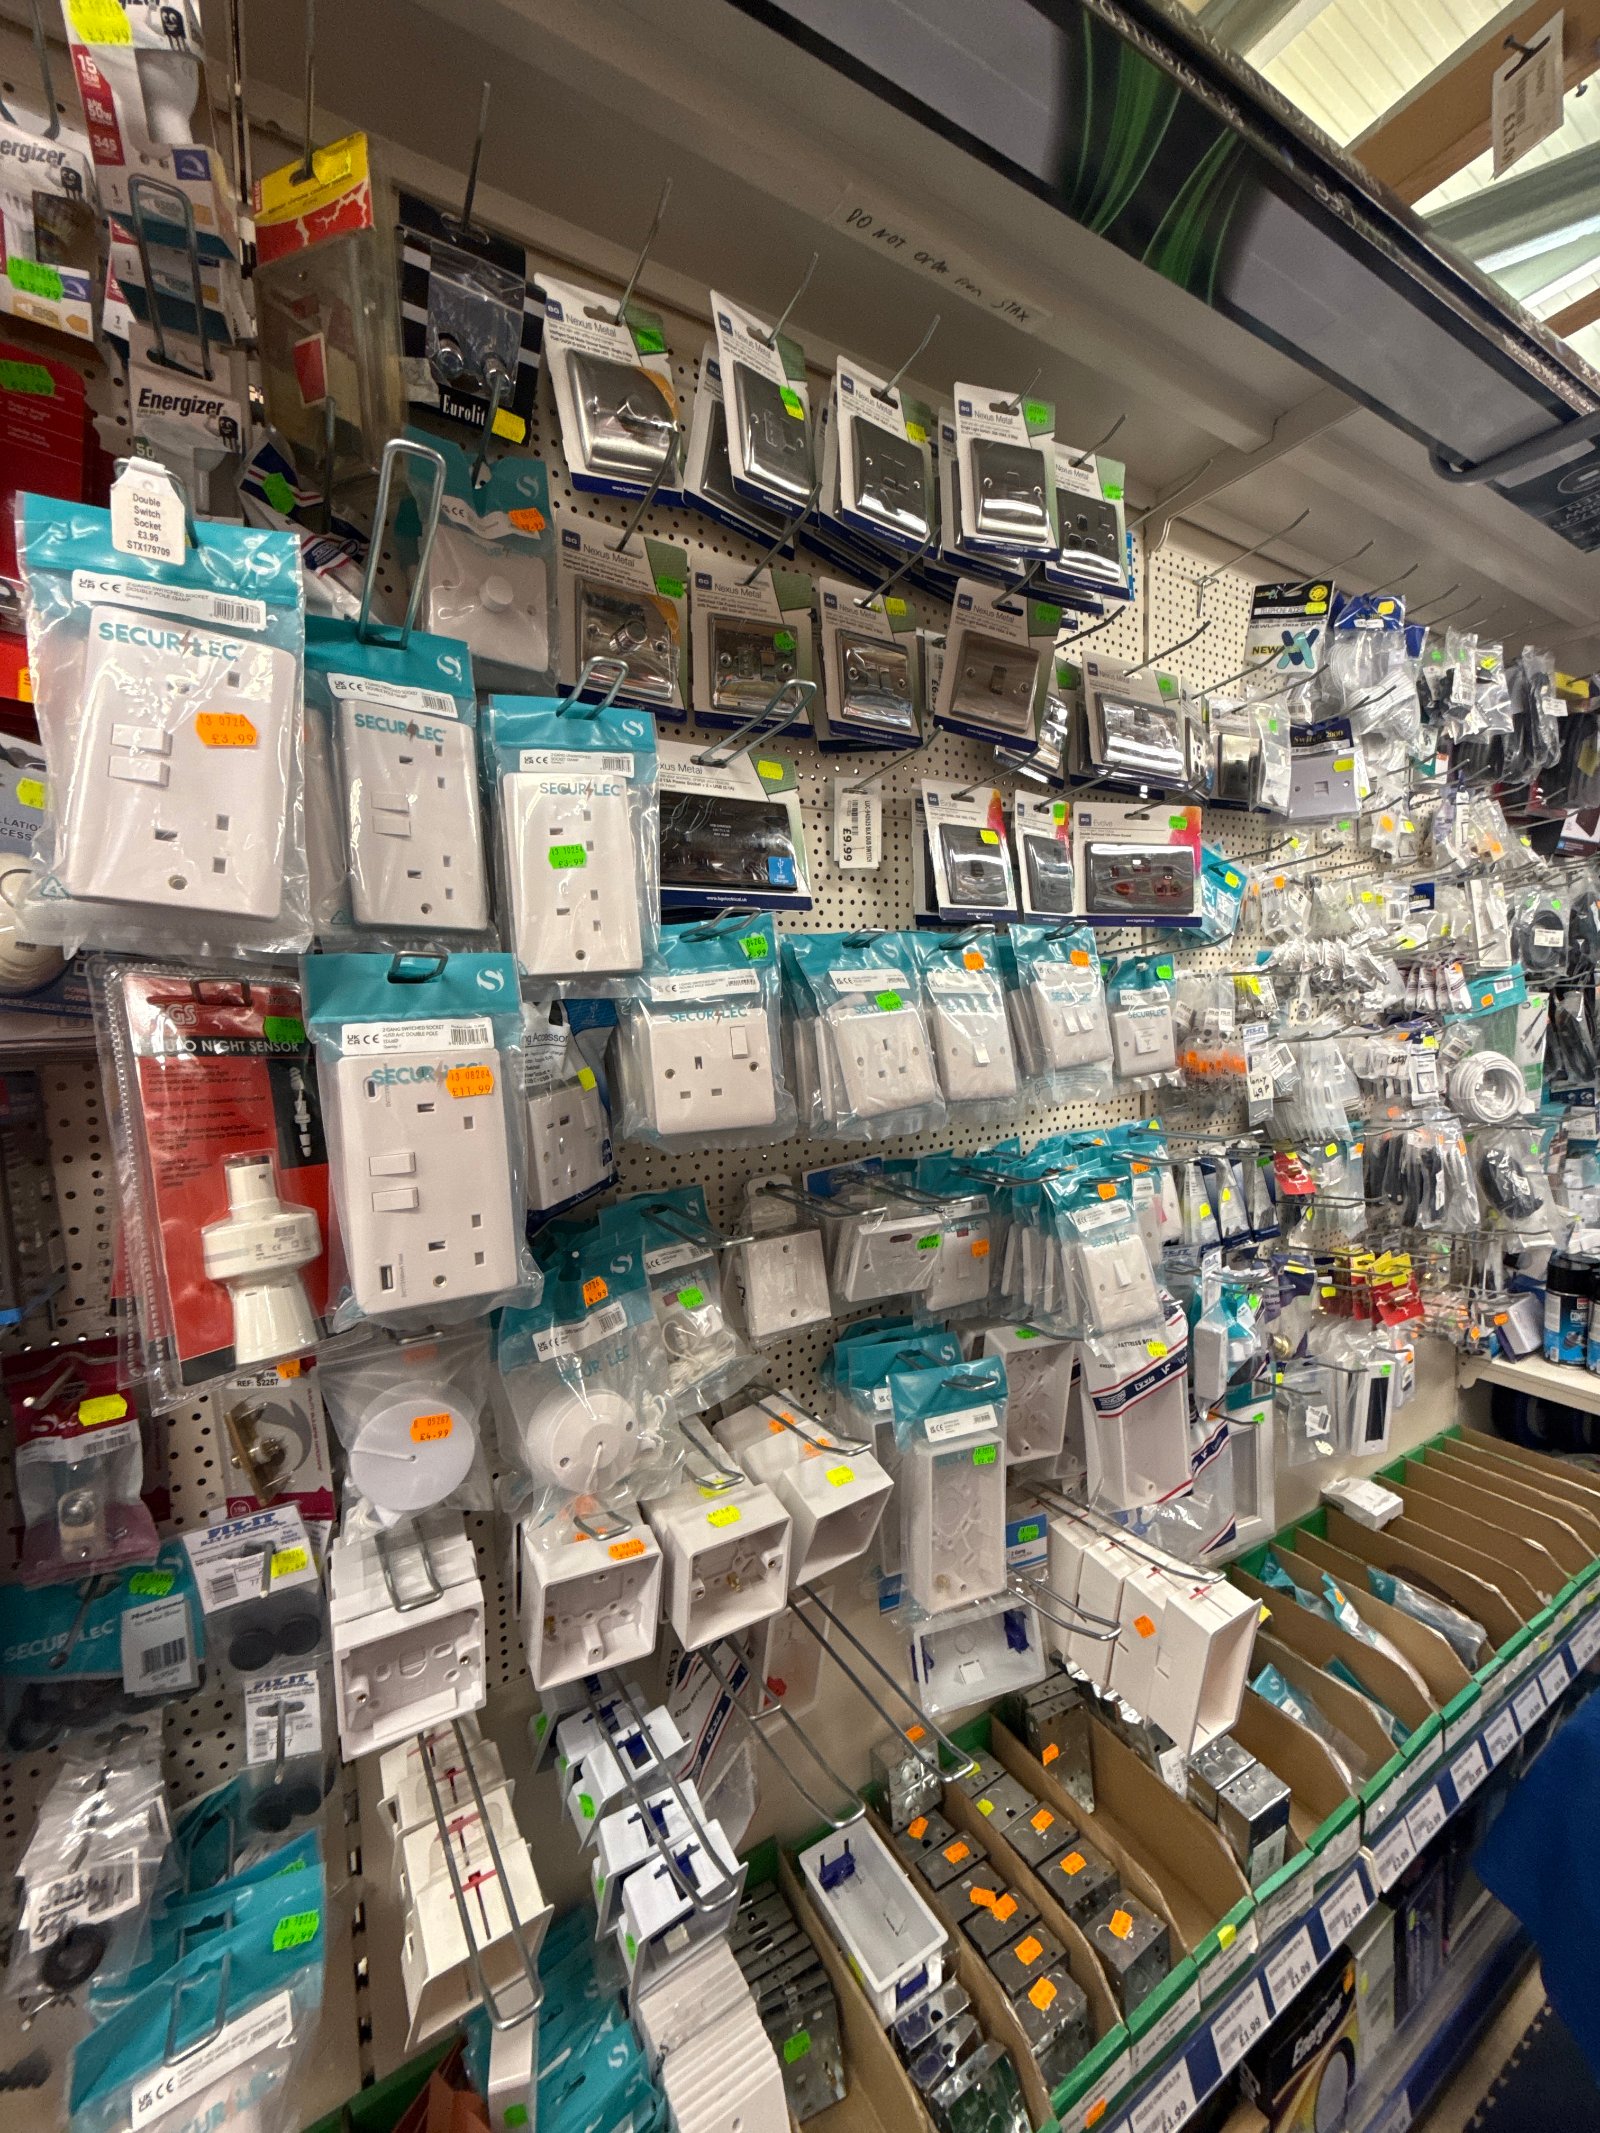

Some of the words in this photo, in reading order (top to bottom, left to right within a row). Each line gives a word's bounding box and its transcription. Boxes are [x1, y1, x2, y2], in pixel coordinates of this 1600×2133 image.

[78, 54, 98, 74] 15
[846, 208, 873, 229] DO
[872, 228, 907, 248] NOT
[565, 313, 593, 331] Nexus
[594, 321, 617, 338] Metal
[138, 387, 225, 417] Energizer
[441, 393, 486, 426] Eurolit
[974, 410, 995, 421] Nexus
[995, 413, 1014, 425] Metal
[131, 492, 161, 508] Double
[133, 505, 161, 519] Switch
[133, 517, 162, 531] Socket
[137, 530, 160, 543] £3.99
[126, 539, 171, 557] STX179709
[583, 544, 610, 560] Nexus
[612, 552, 635, 568] Metal
[126, 586, 153, 595] DOUBLE
[153, 591, 171, 599] POLE
[714, 584, 739, 595] Nexus
[740, 588, 762, 599] Metal
[974, 605, 995, 617] Nexus
[996, 612, 1015, 623] Metal
[211, 734, 254, 745] £3.99
[678, 763, 703, 775] Metal
[842, 827, 853, 862] £9.99
[558, 858, 585, 868] £3.99
[669, 1008, 748, 1024] SECURLEC
[201, 1039, 248, 1053] NIGHT
[250, 1038, 299, 1053] SENSOR
[452, 1084, 491, 1097] £11.99
[420, 1428, 449, 1441] £4.99
[1290, 1960, 1312, 1990] £1.99
[1238, 2016, 1261, 2048] £1.99
